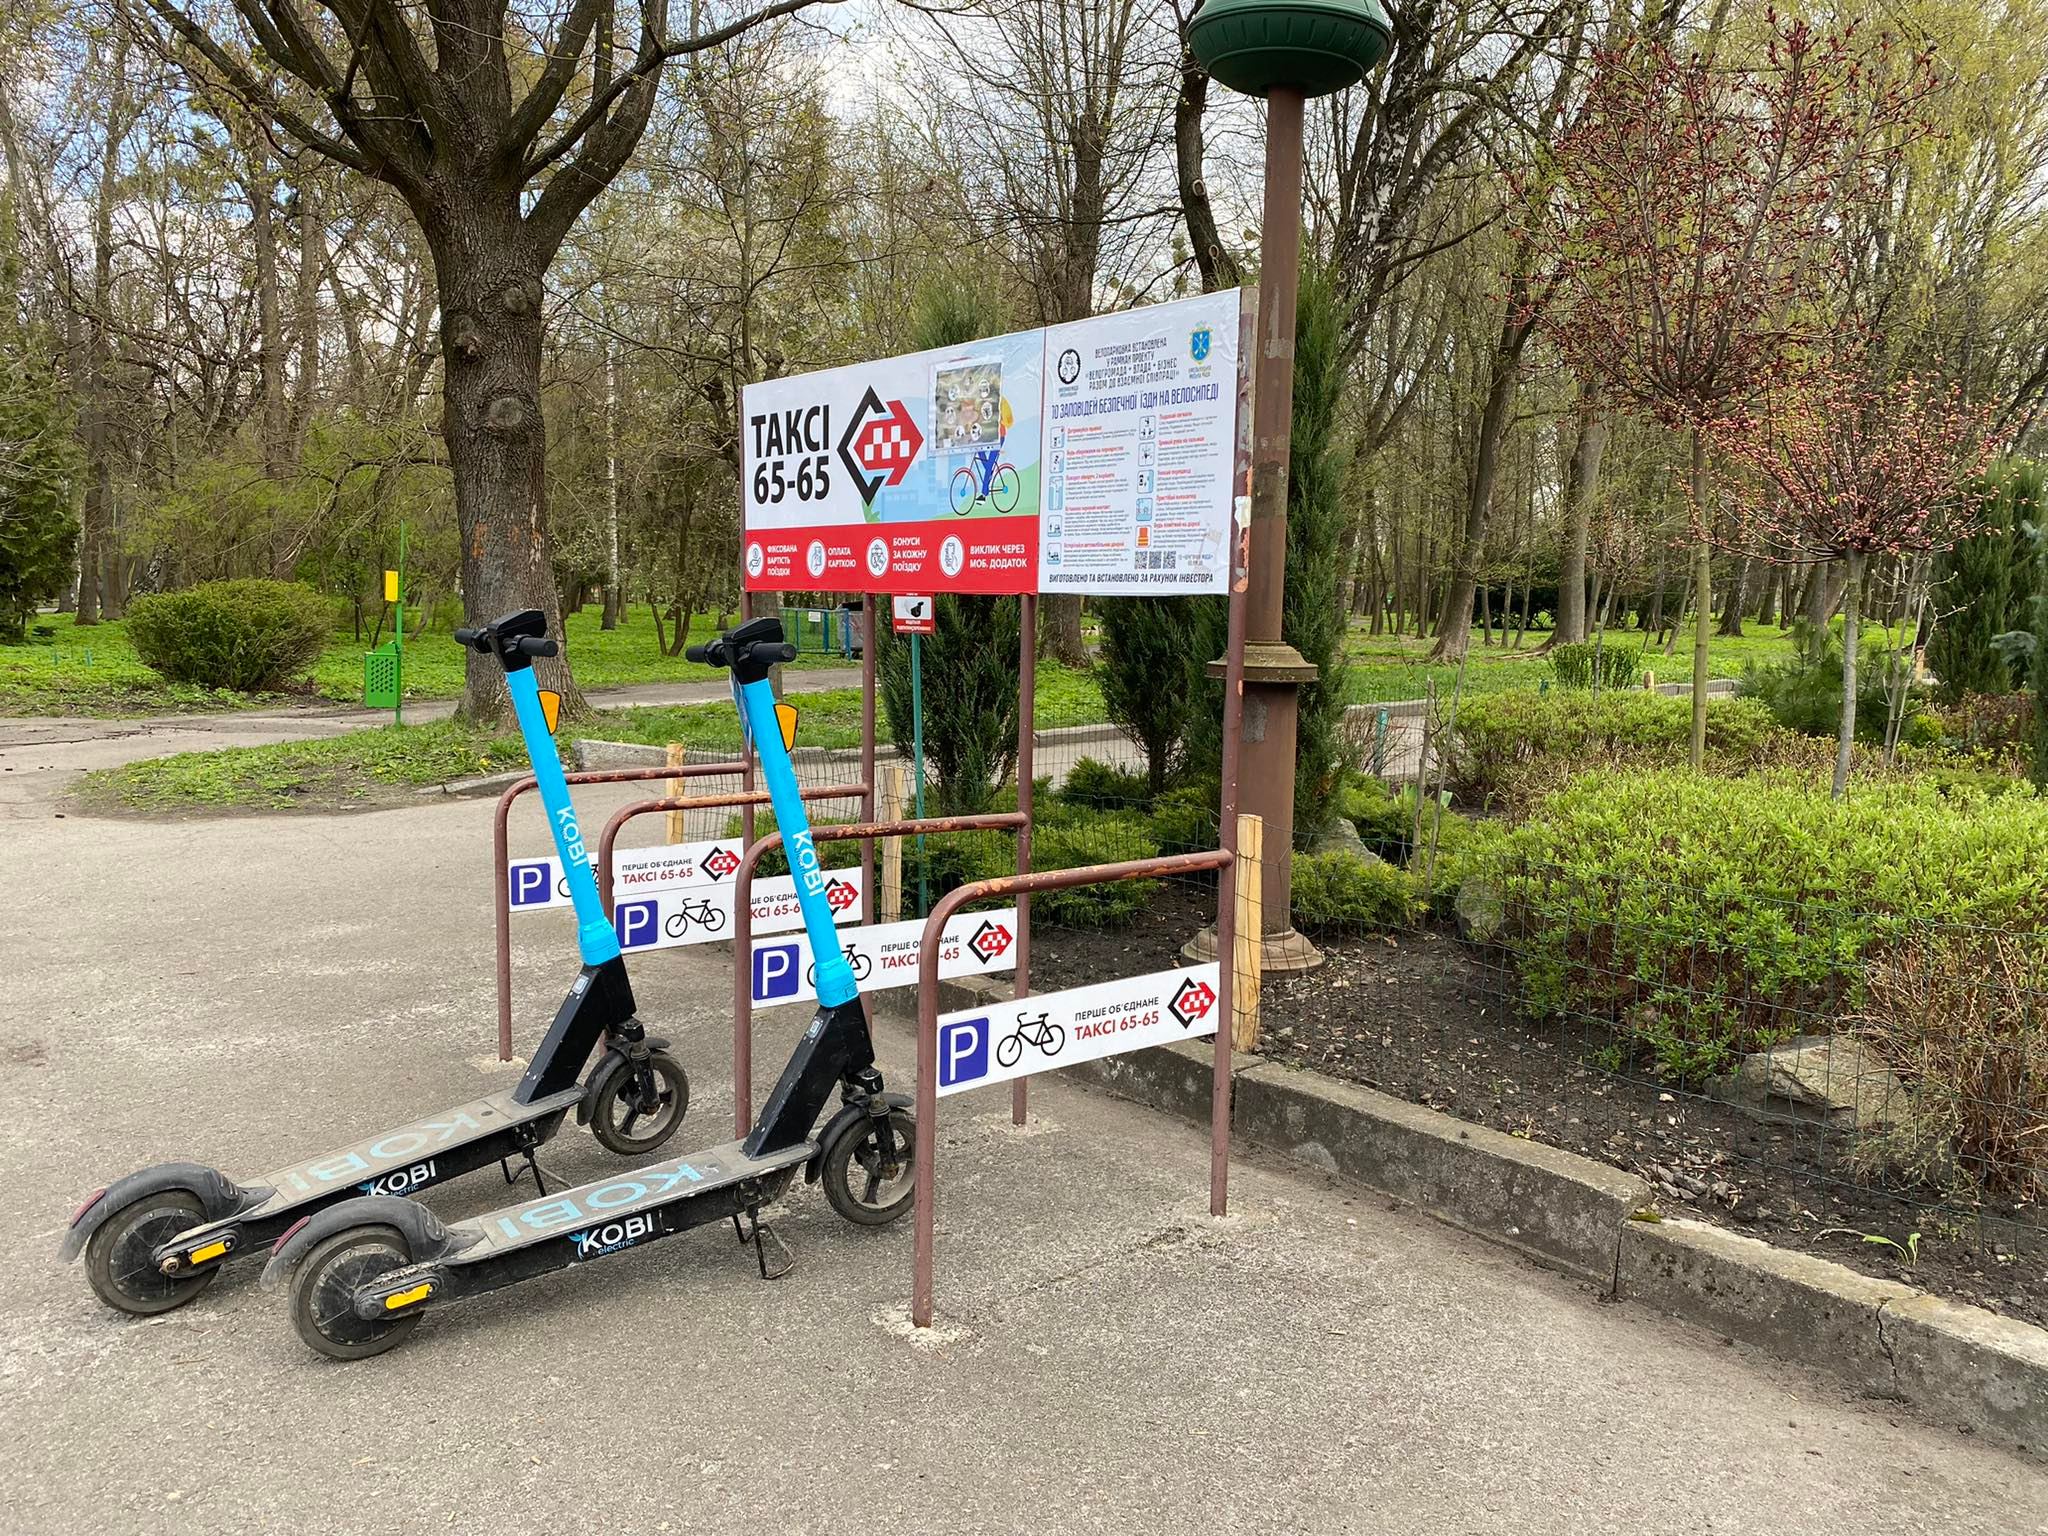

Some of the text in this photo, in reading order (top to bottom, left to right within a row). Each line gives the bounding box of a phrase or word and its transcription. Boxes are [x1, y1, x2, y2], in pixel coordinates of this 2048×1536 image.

[1052, 404, 1059, 419] 10
[1060, 397, 1098, 418] ЗАПОВІДЕЙ
[1099, 391, 1138, 414] БЕЗПЕЧНОЇ
[1139, 390, 1158, 409] ЇЗДИ
[1159, 390, 1169, 405] НА
[1171, 383, 1219, 405] ВЕЛОСИПЕДІ
[751, 404, 830, 458] ТАКСІ
[754, 455, 830, 504] 65-65
[767, 544, 798, 553] ФІКСОВАНА
[892, 537, 921, 546] БОНУСИ
[970, 544, 1025, 555] ВИКЛИК ЧЕРЕЗ
[828, 547, 851, 556] ОПЛАТА
[893, 550, 927, 559] ЗА КОЖНУ
[767, 557, 791, 565] ВАРТІСТЬ
[828, 559, 856, 568] КАРТКОЮ
[893, 561, 921, 572] ПОЇЗДКУ
[970, 558, 1027, 569] МОБ. ДОДАТОК
[1049, 573, 1214, 584] ВИГОТОВЛЕНО ТА ВСТАНОВЛЕНО ЗА РАХУНОК ІНВЕСТОРА
[556, 806, 588, 867] KOBI
[622, 862, 648, 871] ПЕРШЕ
[792, 829, 825, 897] KOBI
[622, 868, 693, 884] ТАКСІ 65-65
[518, 867, 543, 903] P
[774, 903, 800, 916] 65-6
[624, 905, 650, 945] P
[881, 941, 910, 953] ПЕРШЕ
[880, 952, 919, 969] ТАКСІ
[762, 950, 789, 996] P
[1075, 1007, 1106, 1022] ПЕРШЕ
[1074, 1011, 1160, 1041] ТАКСІ 65-65
[950, 1026, 979, 1082] P
[287, 1112, 481, 1191] KOBI
[369, 1160, 438, 1196] KOBI
[390, 1183, 420, 1196] lectric
[496, 1163, 704, 1239] KOBI
[582, 1213, 654, 1253] KOBI
[597, 1238, 635, 1255] electric
